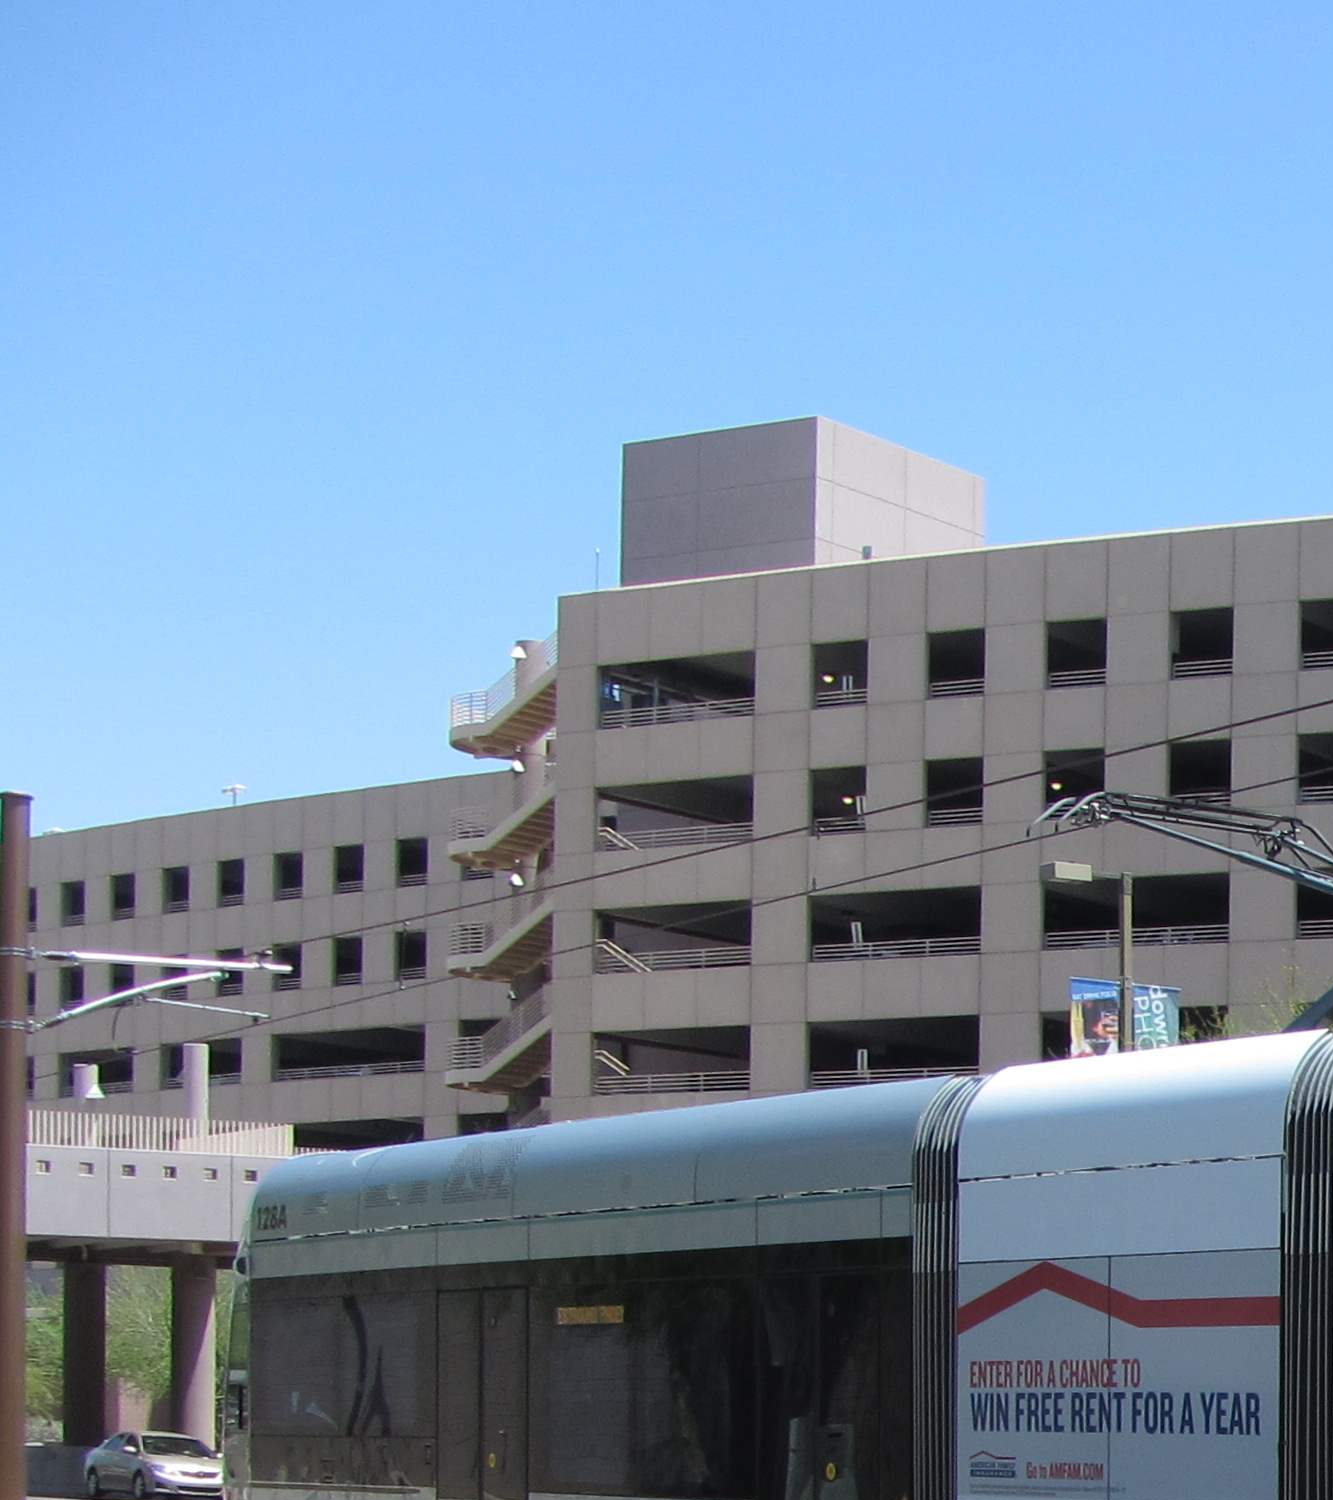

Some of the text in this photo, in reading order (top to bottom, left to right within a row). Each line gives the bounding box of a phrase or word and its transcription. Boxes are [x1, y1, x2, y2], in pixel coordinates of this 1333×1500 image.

[257, 1204, 288, 1230] 128A
[969, 1358, 1141, 1388] ENTER FOR A CHANCE TO
[970, 1391, 1261, 1436] WIN FREE RENT FOR A YEAR
[1026, 1462, 1037, 1479] Go
[1038, 1464, 1048, 1479] to
[1049, 1462, 1104, 1480] AMFAM.COM
